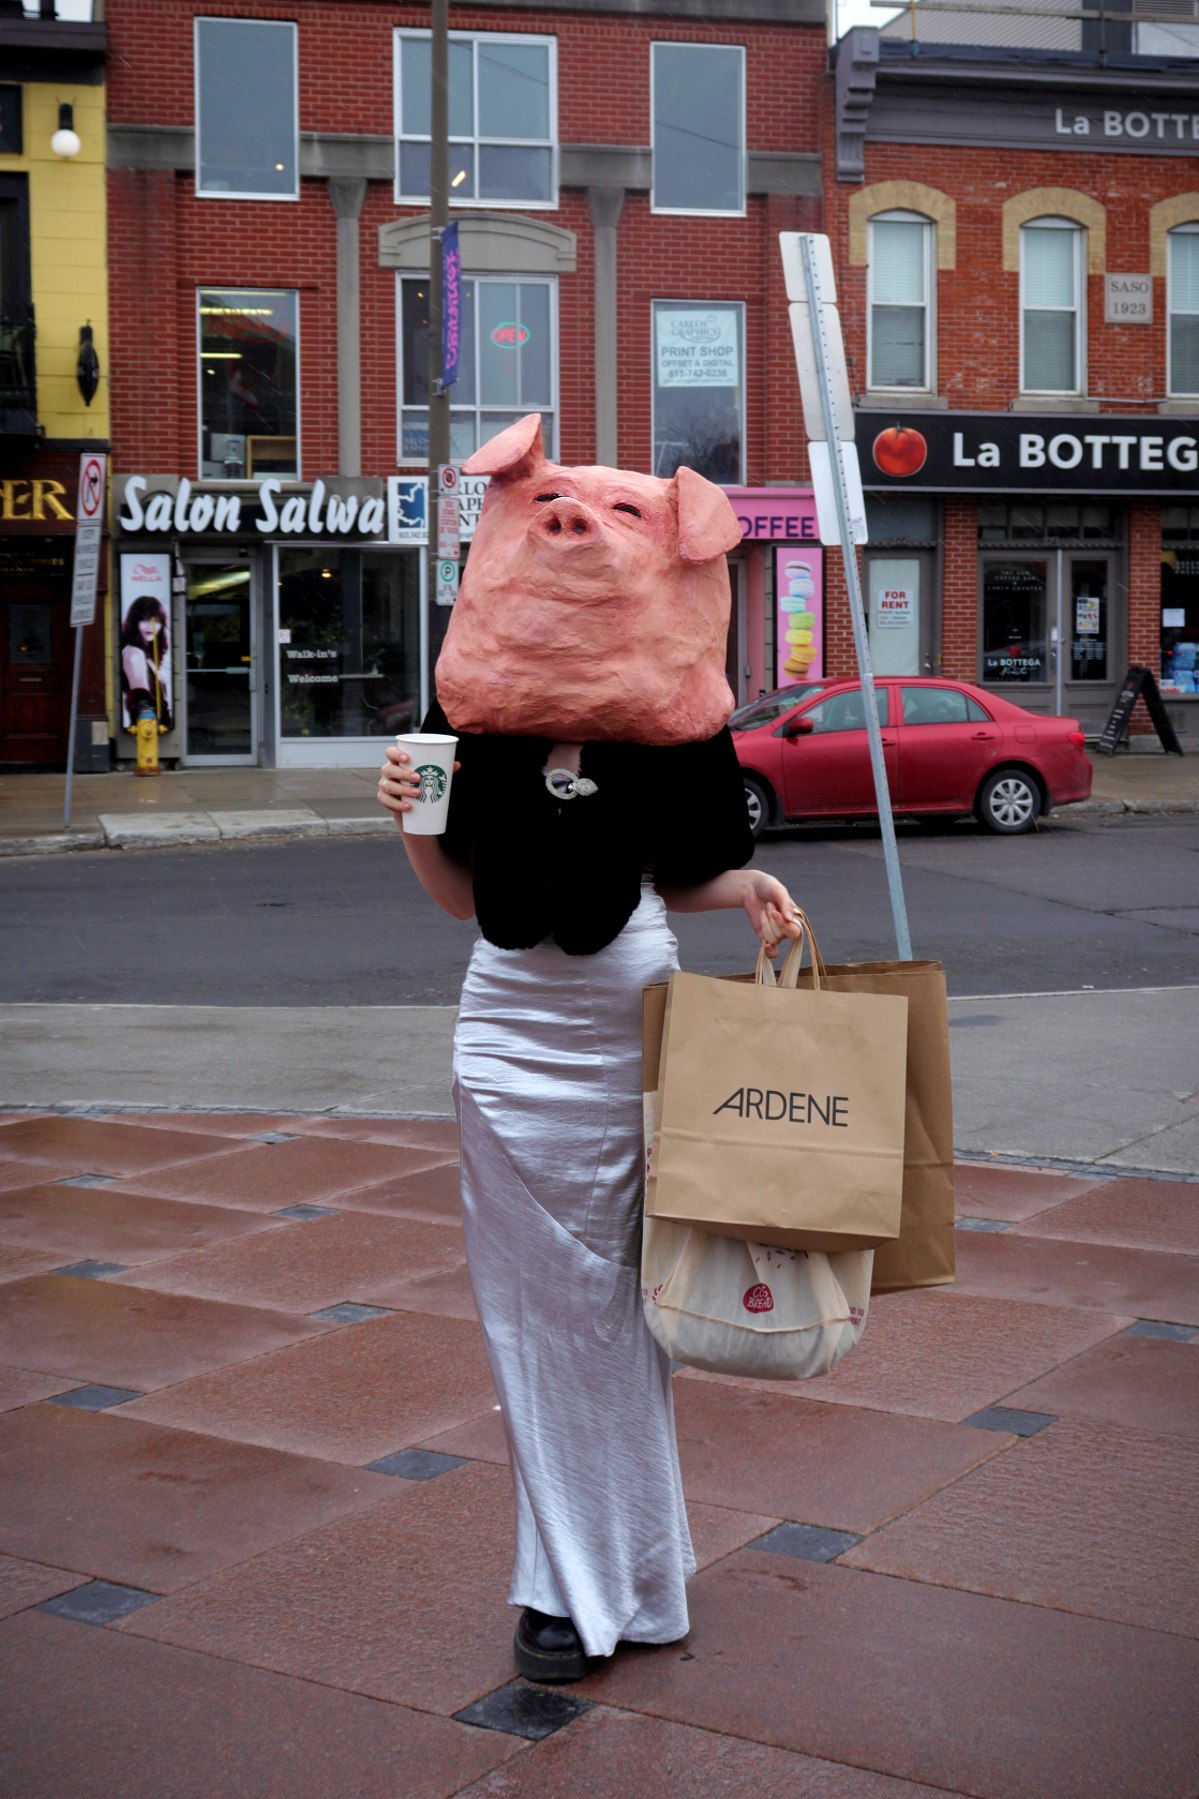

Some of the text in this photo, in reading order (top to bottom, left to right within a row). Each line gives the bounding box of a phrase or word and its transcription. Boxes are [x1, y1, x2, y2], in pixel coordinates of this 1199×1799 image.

[1056, 108, 1090, 135] La
[1113, 302, 1146, 314] 1923
[493, 328, 527, 343] OPEN
[661, 346, 734, 357] PRINT SHOP
[953, 432, 1000, 467] La
[120, 475, 386, 534] Salon Salwa
[884, 591, 906, 599] FOR
[881, 601, 910, 609] RENT
[286, 649, 337, 659] Walk-in's
[287, 674, 339, 683] Welcome
[713, 1087, 849, 1127] ARDENE
[747, 1297, 774, 1309] BREAD
